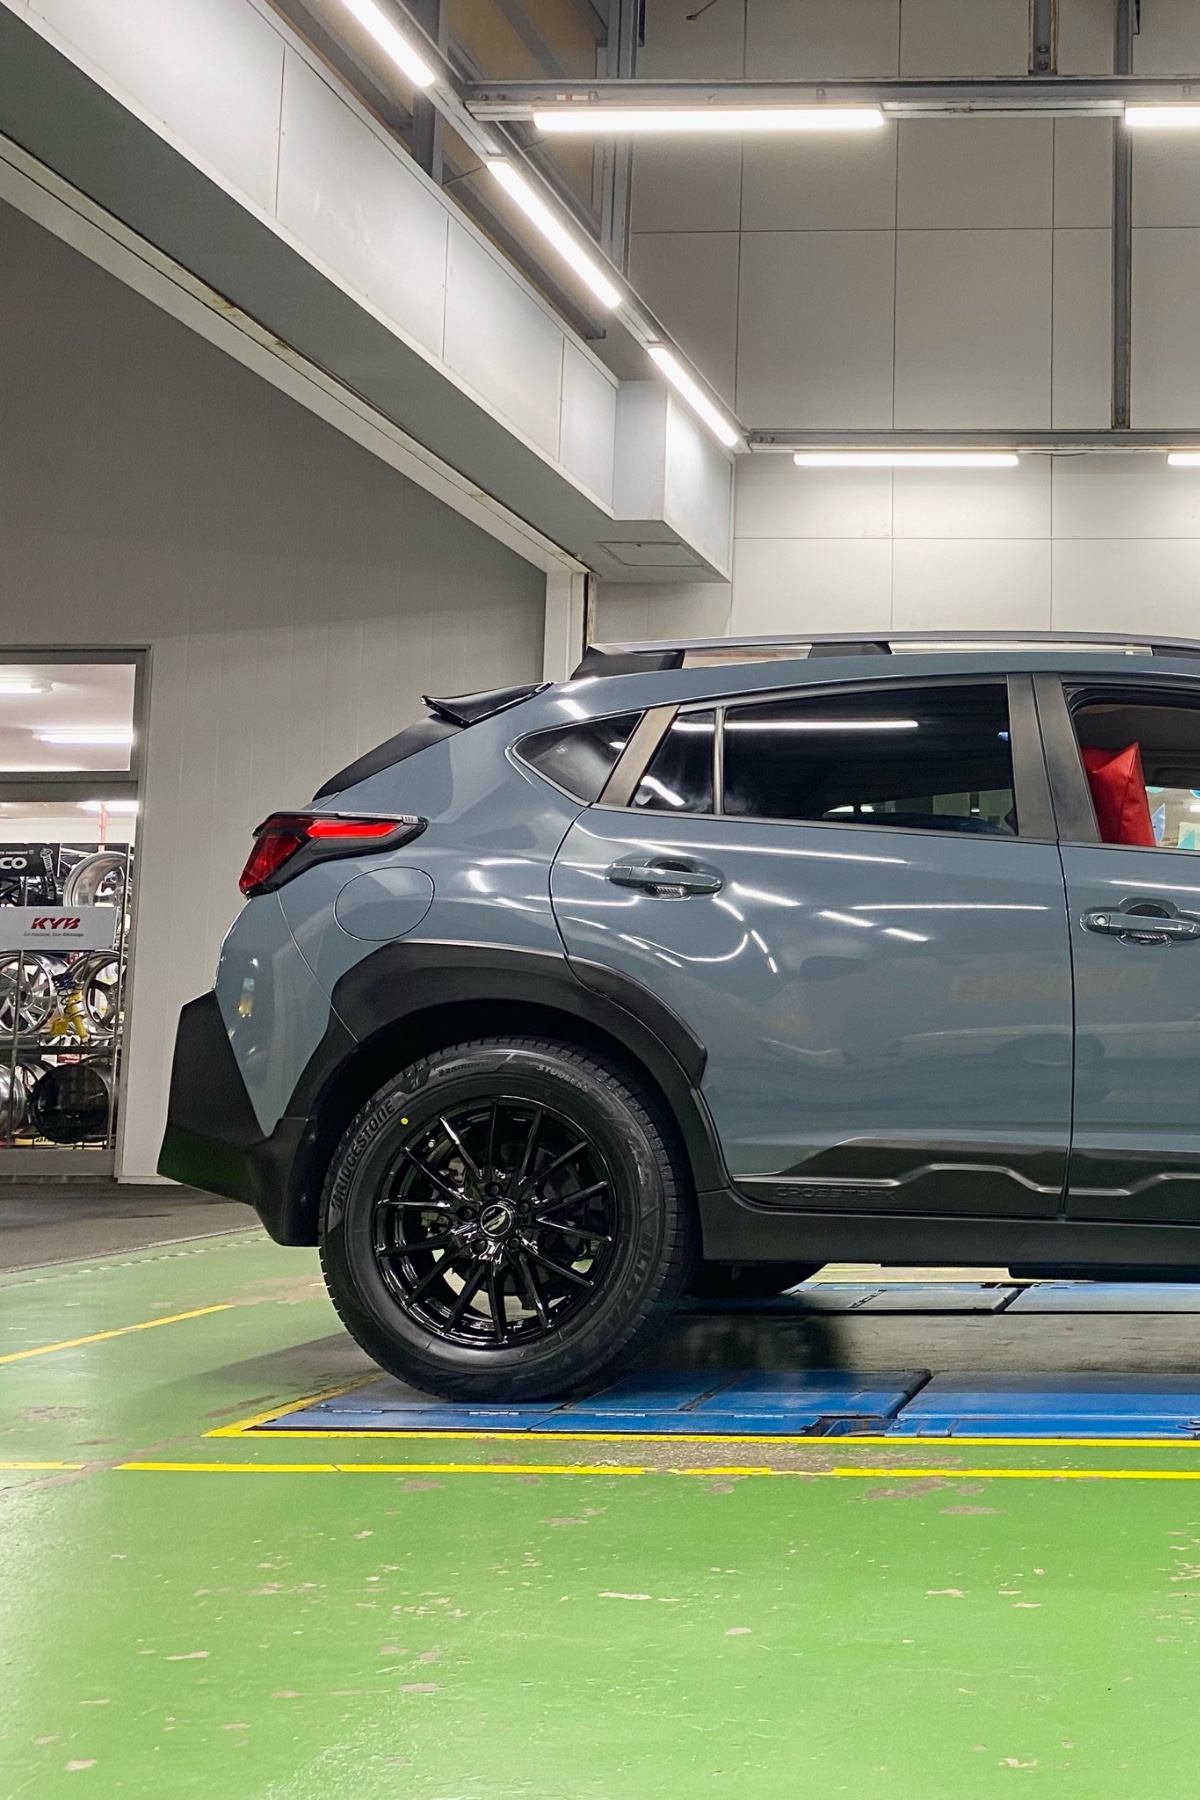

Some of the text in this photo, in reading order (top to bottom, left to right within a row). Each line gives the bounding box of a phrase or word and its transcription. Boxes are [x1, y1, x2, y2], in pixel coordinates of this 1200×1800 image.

[31, 917, 81, 930] KYB
[330, 1097, 396, 1211] BRIDGESTONE
[775, 1186, 898, 1202] CROSSTREK
